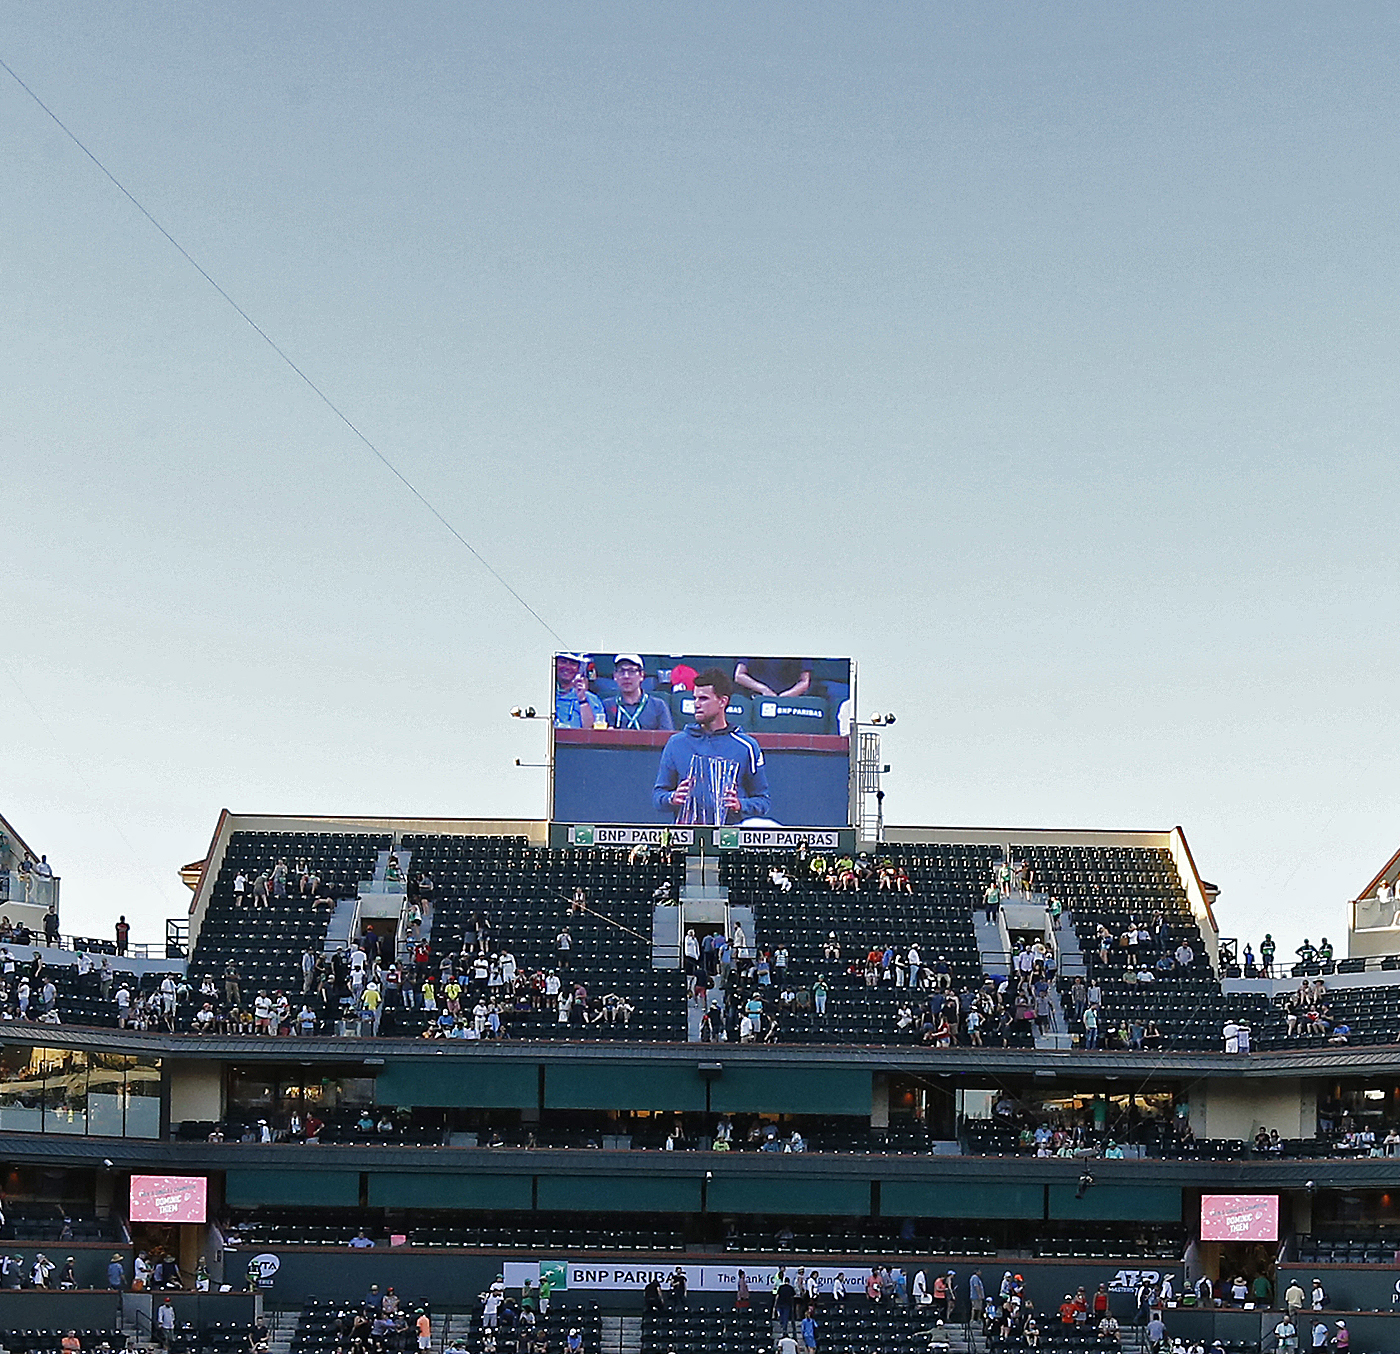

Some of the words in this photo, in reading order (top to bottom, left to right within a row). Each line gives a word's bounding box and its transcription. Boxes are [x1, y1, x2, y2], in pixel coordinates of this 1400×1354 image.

[599, 830, 626, 841] BNP
[743, 833, 771, 844] BNP
[572, 1269, 609, 1283] BNP
[718, 1273, 736, 1283] The
[842, 1275, 867, 1285] worl
[1108, 1270, 1160, 1287] ATP
